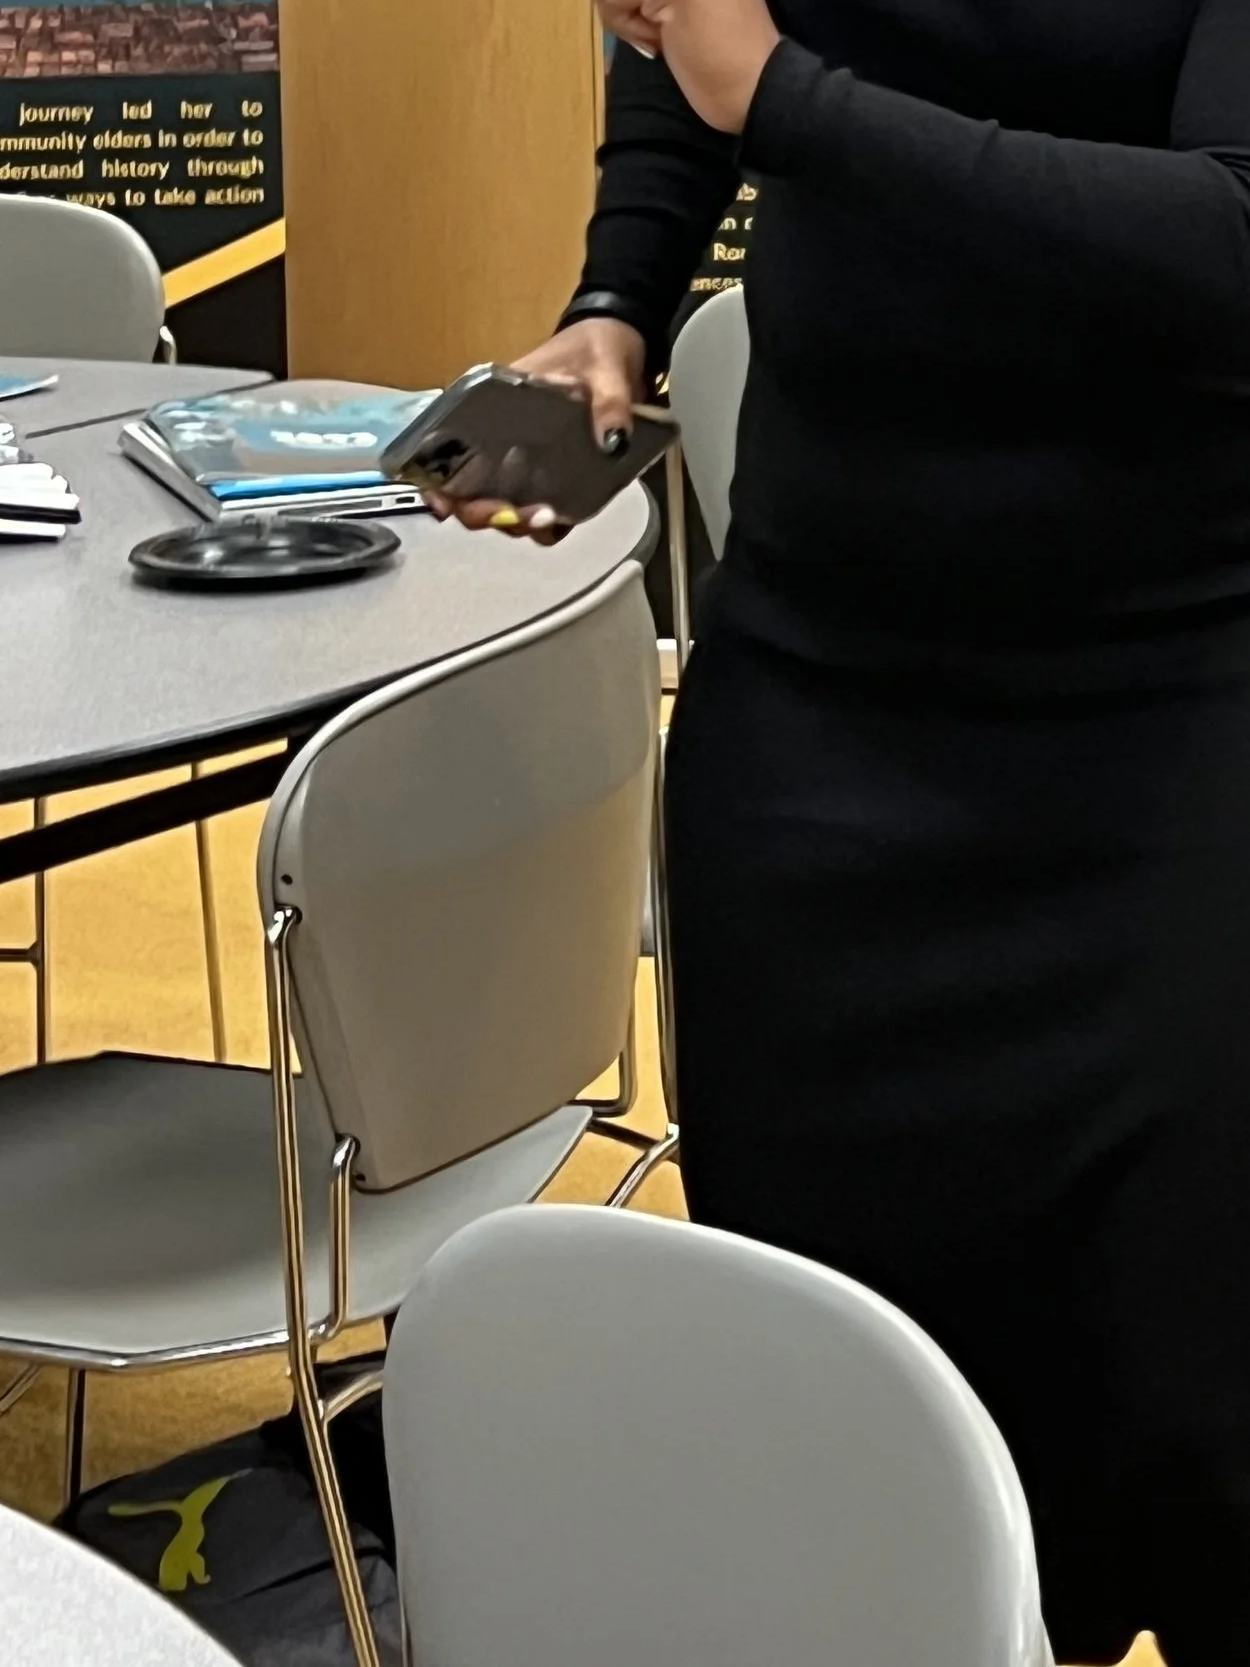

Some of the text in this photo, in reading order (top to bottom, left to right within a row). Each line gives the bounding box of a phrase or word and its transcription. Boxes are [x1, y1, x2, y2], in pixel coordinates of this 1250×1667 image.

[19, 99, 263, 127] journey led her to
[93, 130, 152, 150] elders
[158, 129, 177, 148] in
[183, 128, 236, 148] order
[244, 129, 264, 146] to
[102, 158, 170, 181] history
[188, 156, 264, 179] through
[126, 189, 146, 206] to
[155, 187, 196, 206] take
[205, 185, 265, 206] action
